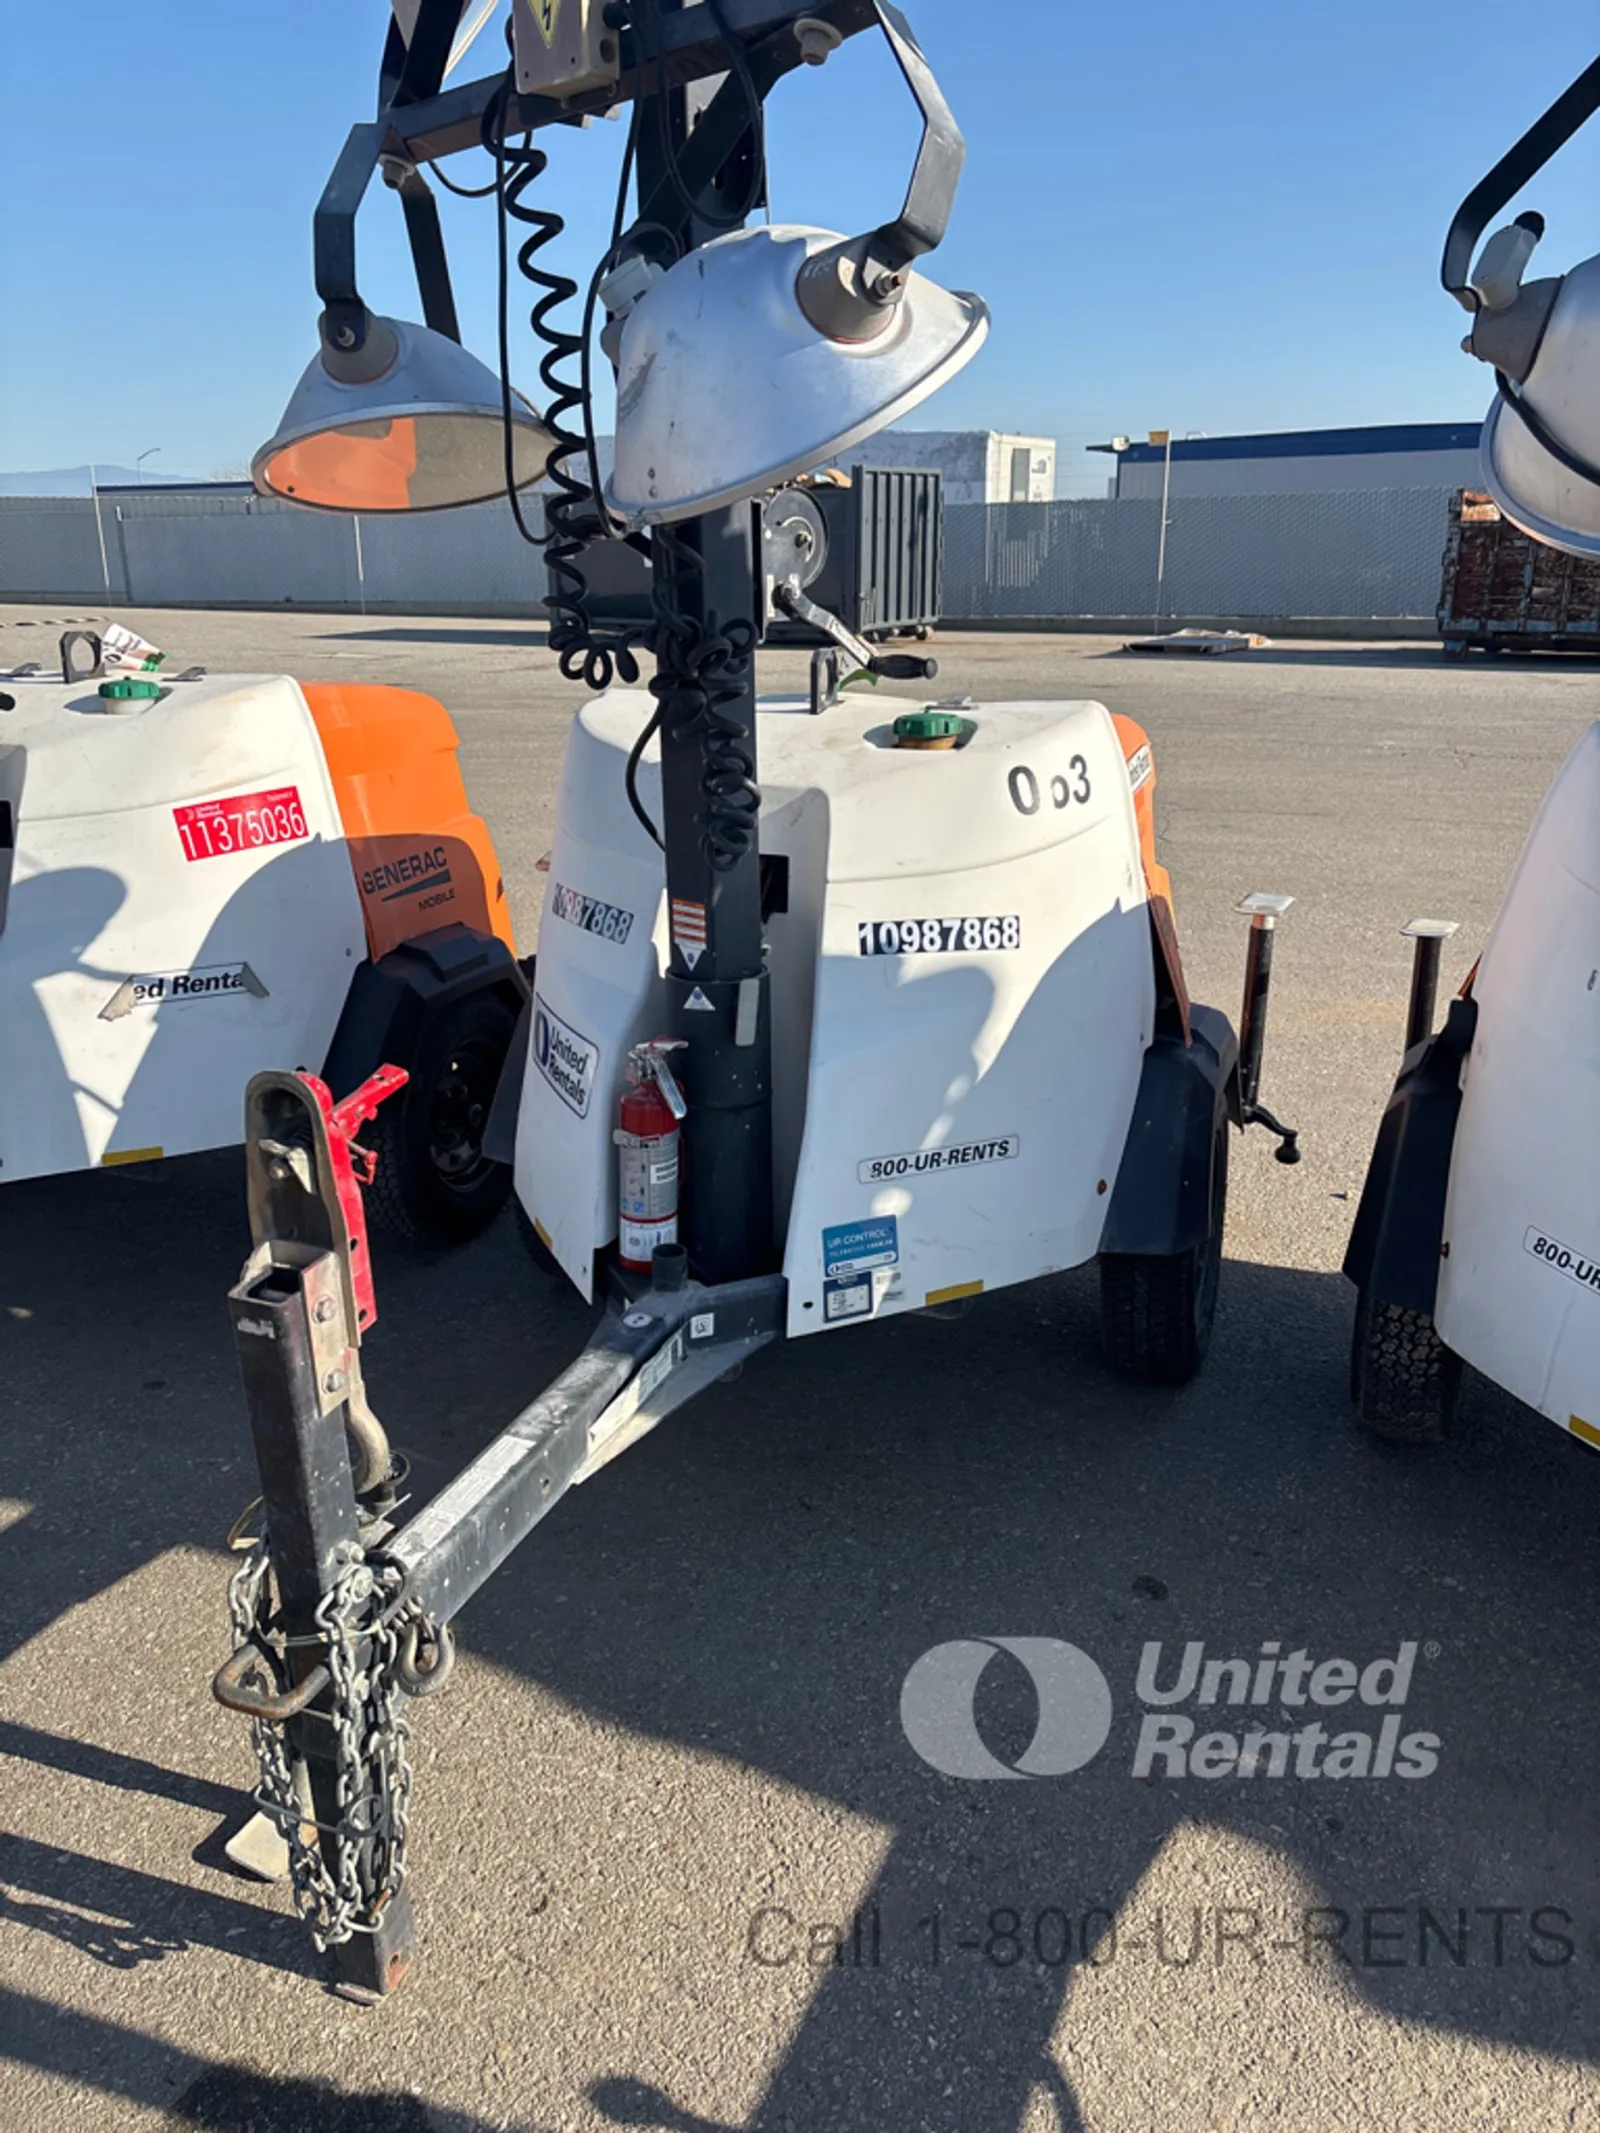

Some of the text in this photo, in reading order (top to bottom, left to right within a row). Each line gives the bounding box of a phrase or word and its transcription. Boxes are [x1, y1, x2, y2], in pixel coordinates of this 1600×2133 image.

[180, 801, 306, 859] 11375036
[362, 846, 447, 895] GENERAC
[859, 916, 1018, 955] 10987868
[551, 1026, 590, 1076] United
[548, 1052, 586, 1105] Rentals
[870, 1140, 1010, 1178] 800-UR-RENTS
